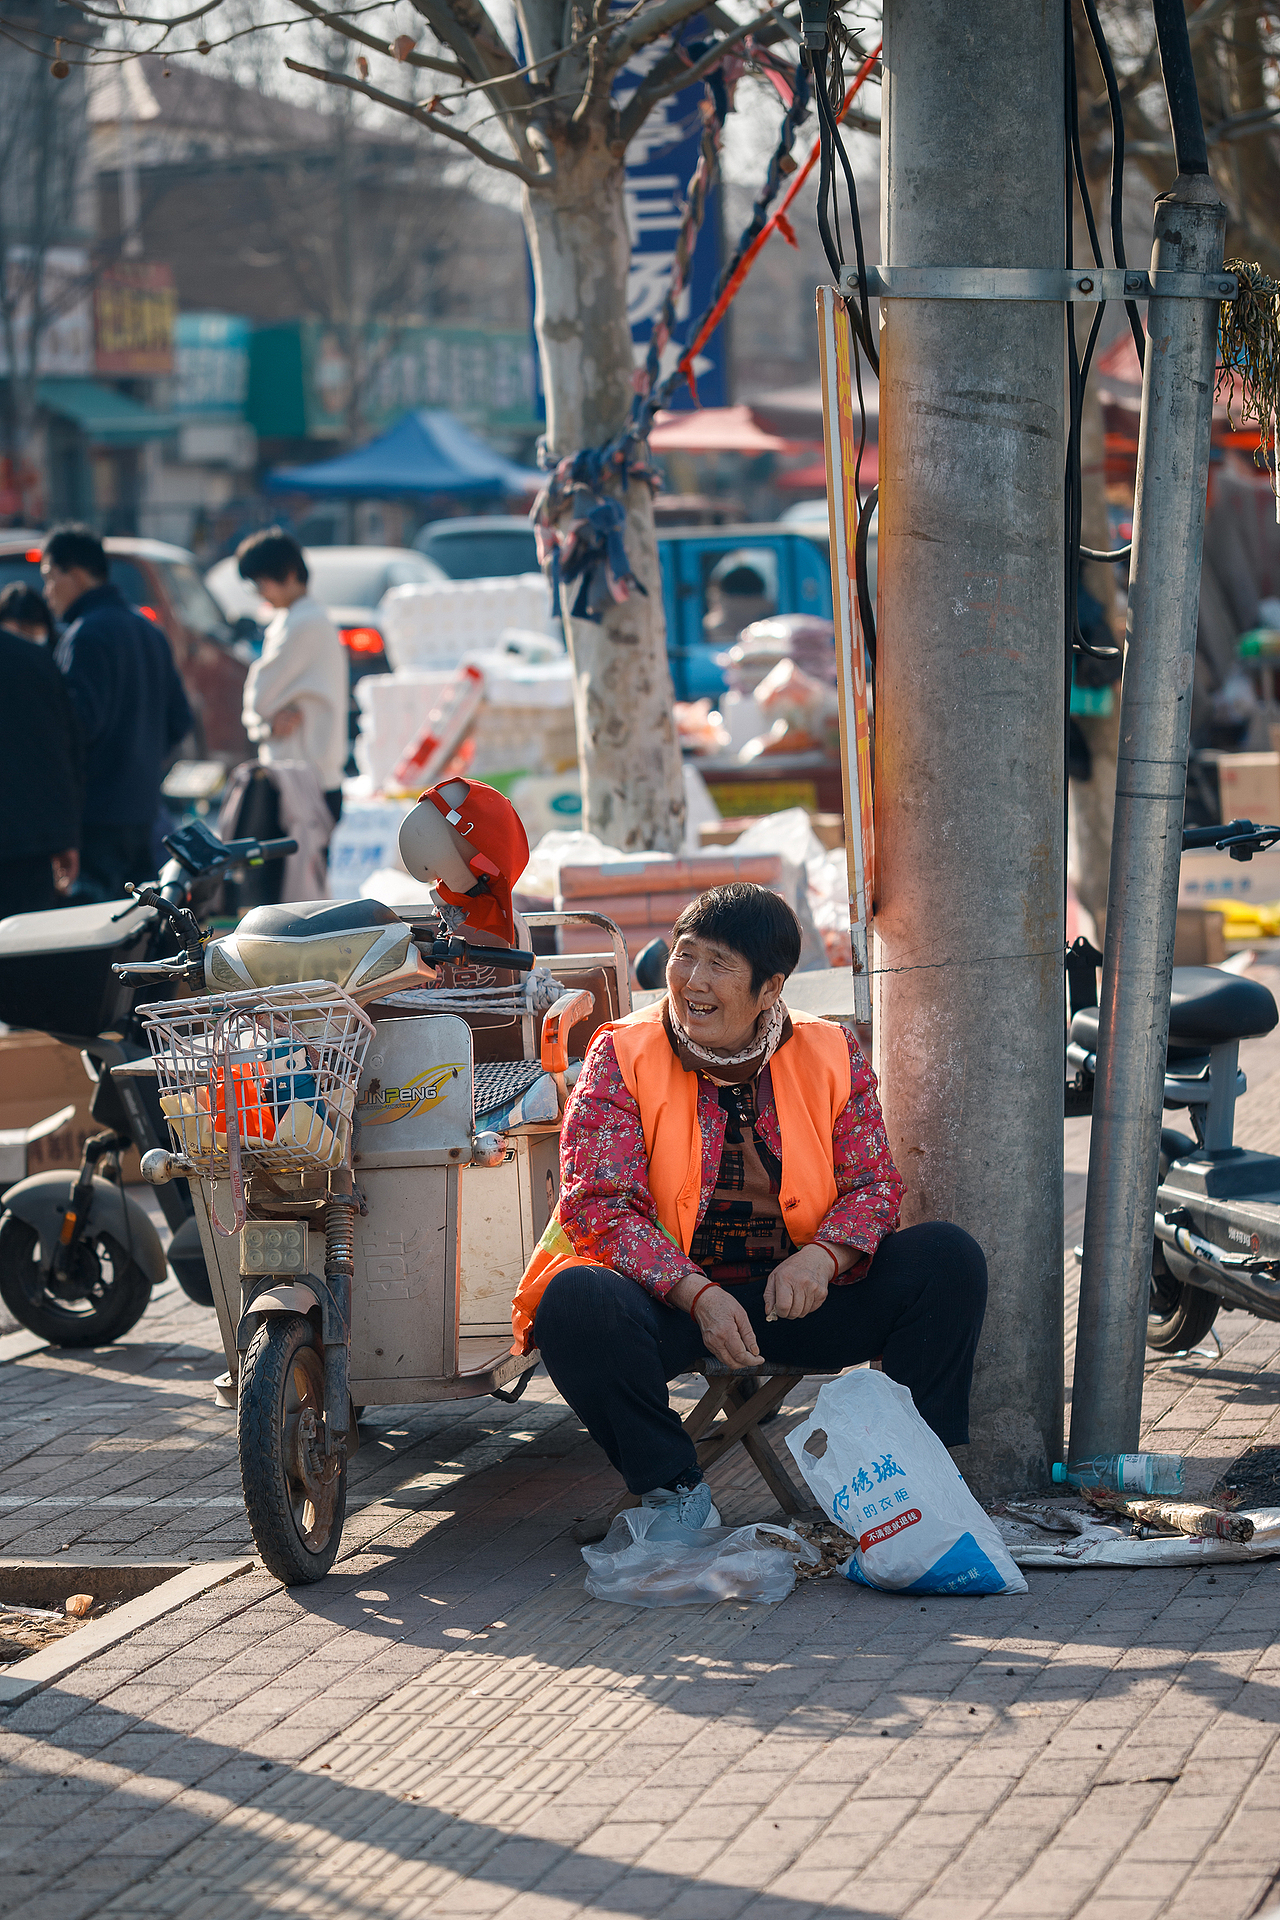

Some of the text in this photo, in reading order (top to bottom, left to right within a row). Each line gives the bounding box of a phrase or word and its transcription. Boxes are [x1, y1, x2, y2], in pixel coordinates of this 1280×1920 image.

[233, 1170, 242, 1199] NAIVETY
[867, 1511, 918, 1542] 不满意就退钱
